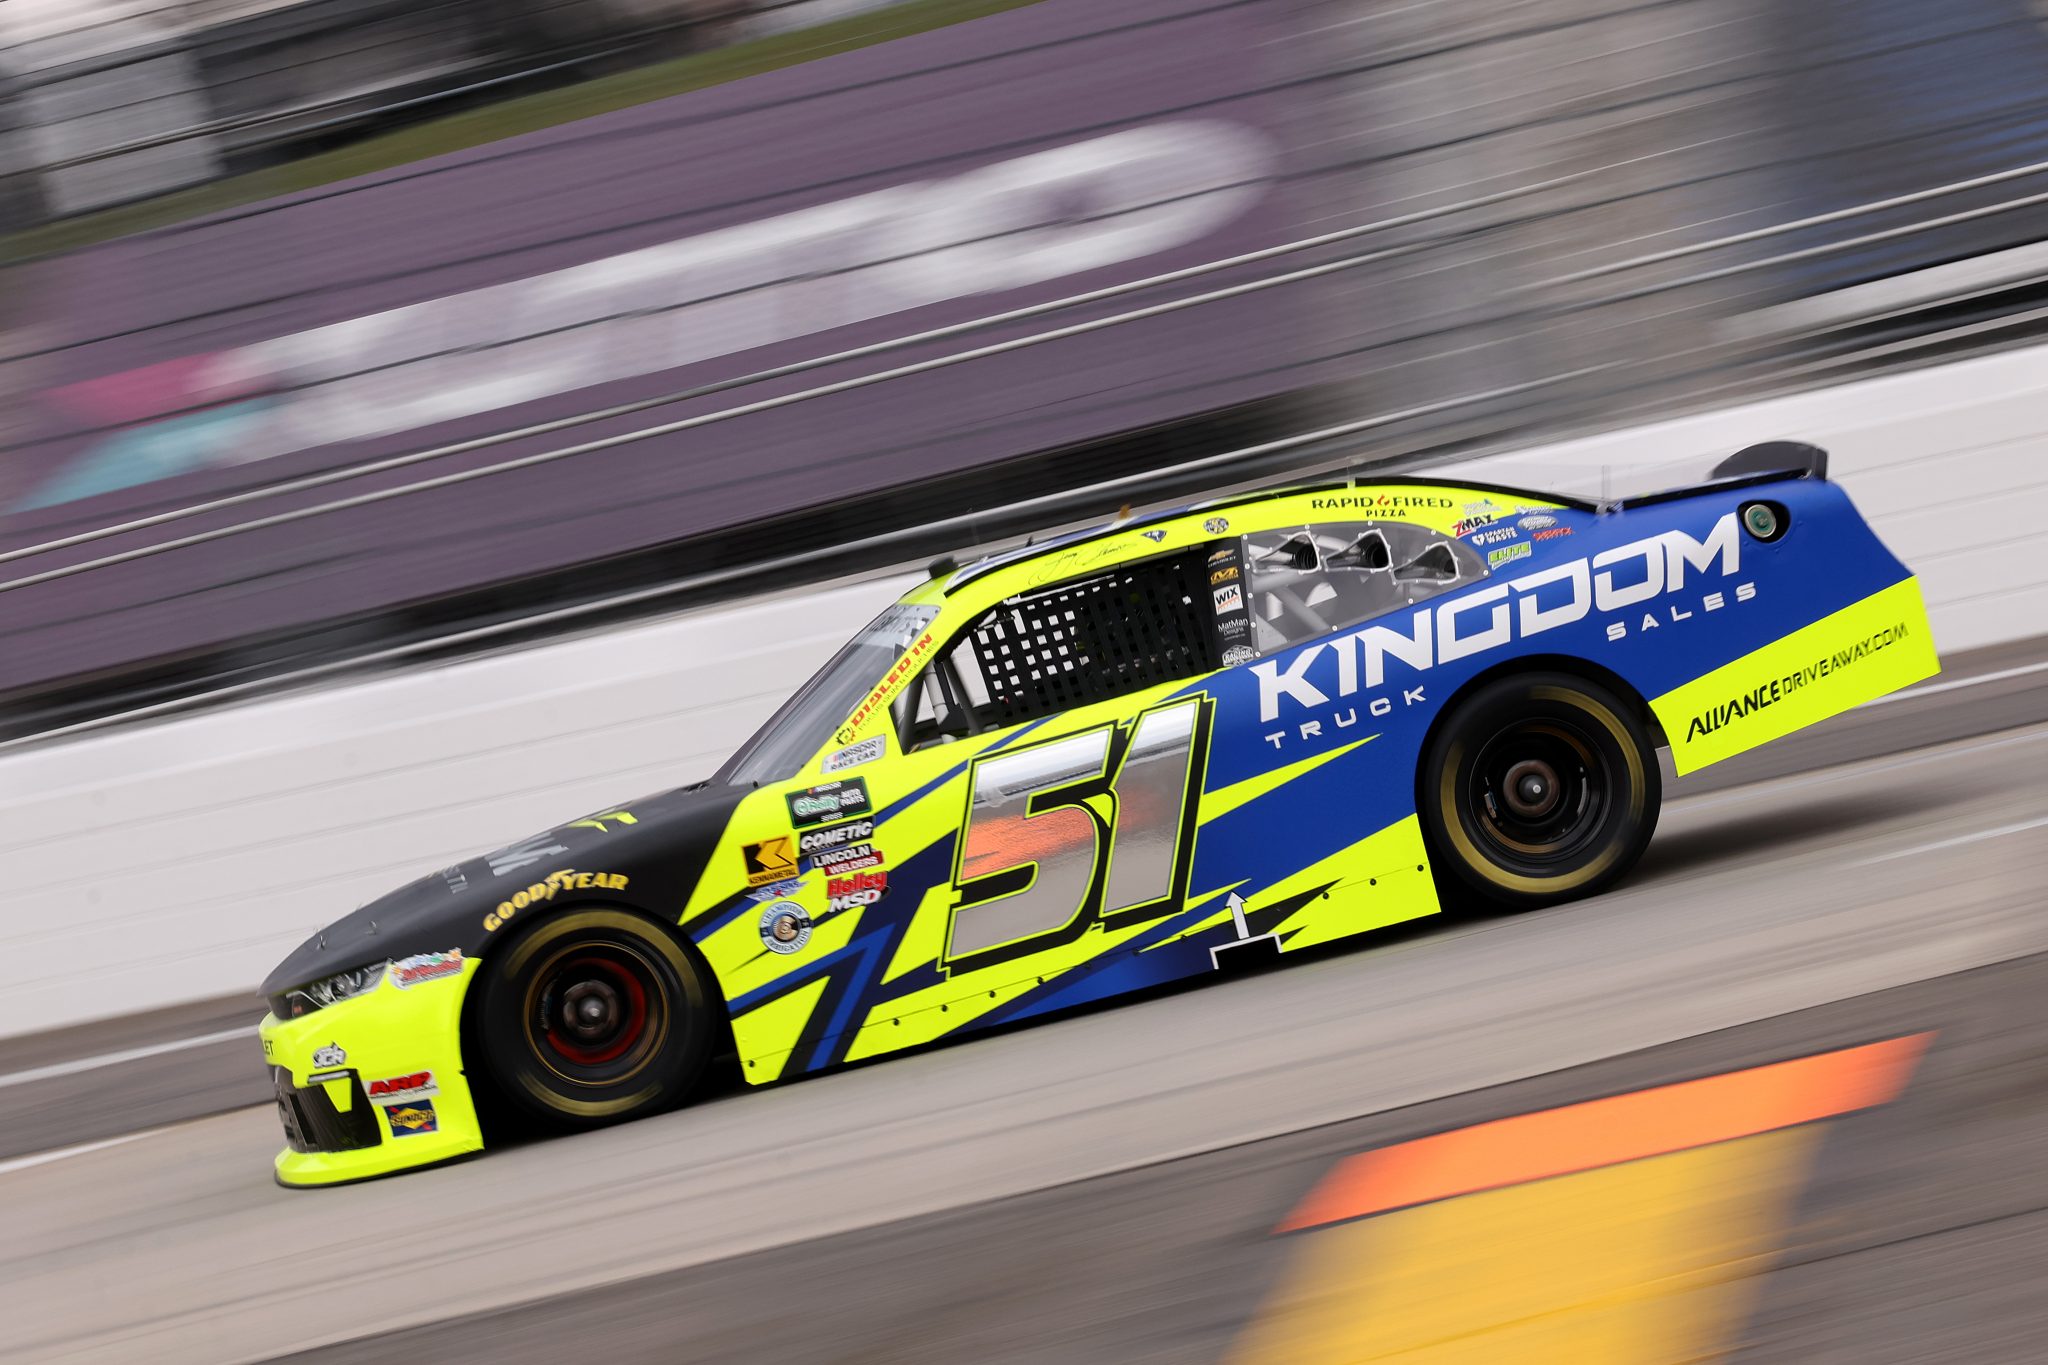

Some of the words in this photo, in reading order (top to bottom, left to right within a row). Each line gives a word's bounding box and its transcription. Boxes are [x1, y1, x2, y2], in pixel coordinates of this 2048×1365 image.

[1311, 497, 1374, 509] RAPID
[1393, 496, 1454, 509] FIRED
[1366, 508, 1407, 518] PIZZA
[1486, 531, 1518, 543] WASTE
[1489, 542, 1530, 563] ELITE
[1216, 587, 1239, 605] WIX
[1247, 511, 1740, 723] KINGDOM
[1606, 581, 1757, 642] SALES
[1217, 617, 1249, 632] MatMan
[911, 633, 933, 657] IN
[1264, 685, 1427, 749] TRUCK
[800, 821, 874, 850] COMETIC
[937, 691, 1216, 978] 51
[813, 845, 871, 867] LINCOLN
[827, 856, 879, 875] WELDERS
[827, 871, 888, 900] Holley
[483, 868, 630, 933] GOODYEAR
[828, 888, 882, 913] MSD
[368, 1071, 432, 1095] ARP
